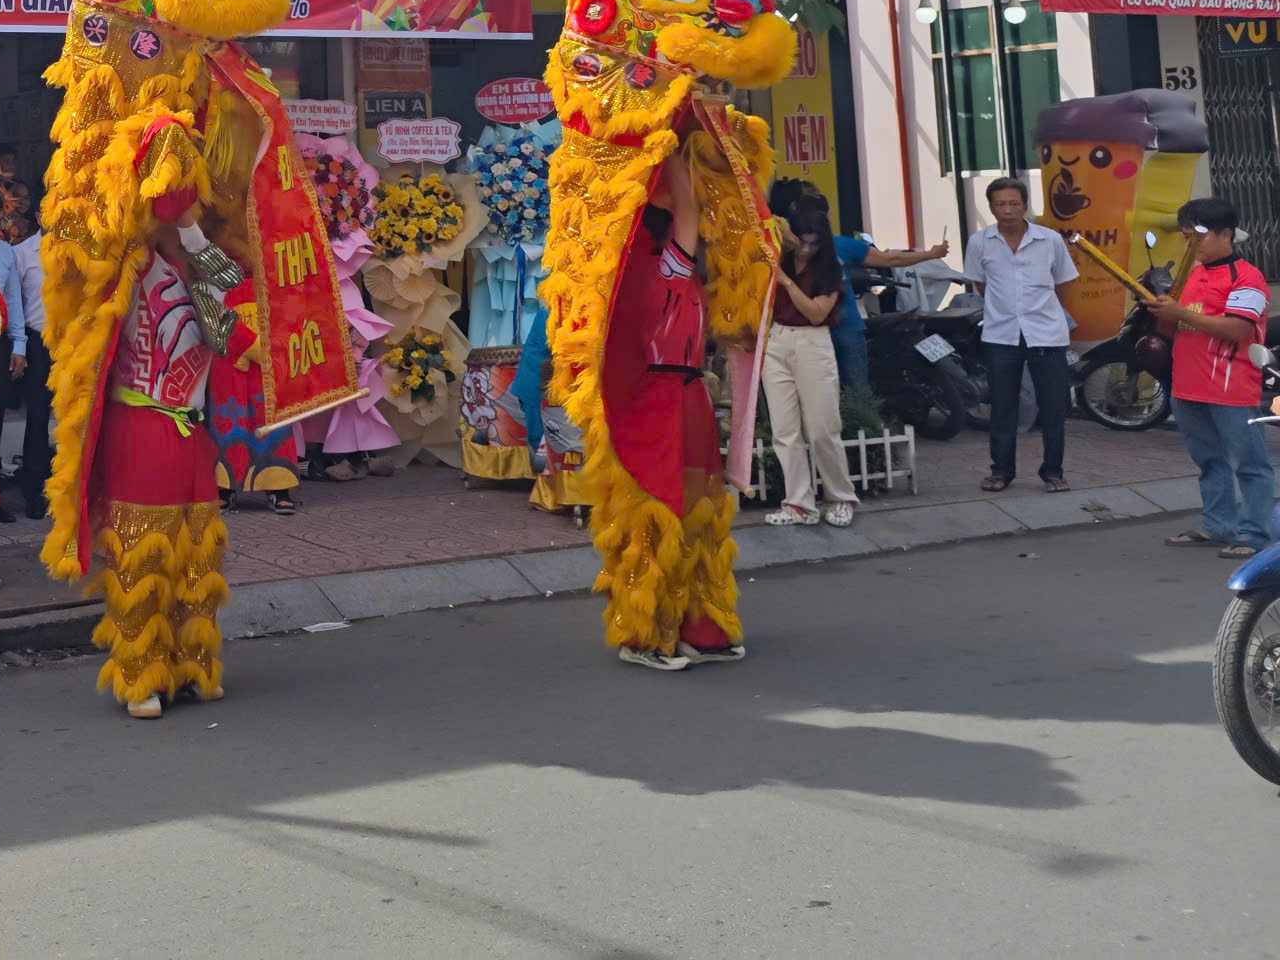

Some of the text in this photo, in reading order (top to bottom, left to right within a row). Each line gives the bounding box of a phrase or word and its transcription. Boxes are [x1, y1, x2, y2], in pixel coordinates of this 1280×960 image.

[1224, 21, 1268, 45] VU
[1165, 66, 1197, 91] 53
[411, 125, 434, 135] COFFEE
[783, 103, 828, 173] NỆM
